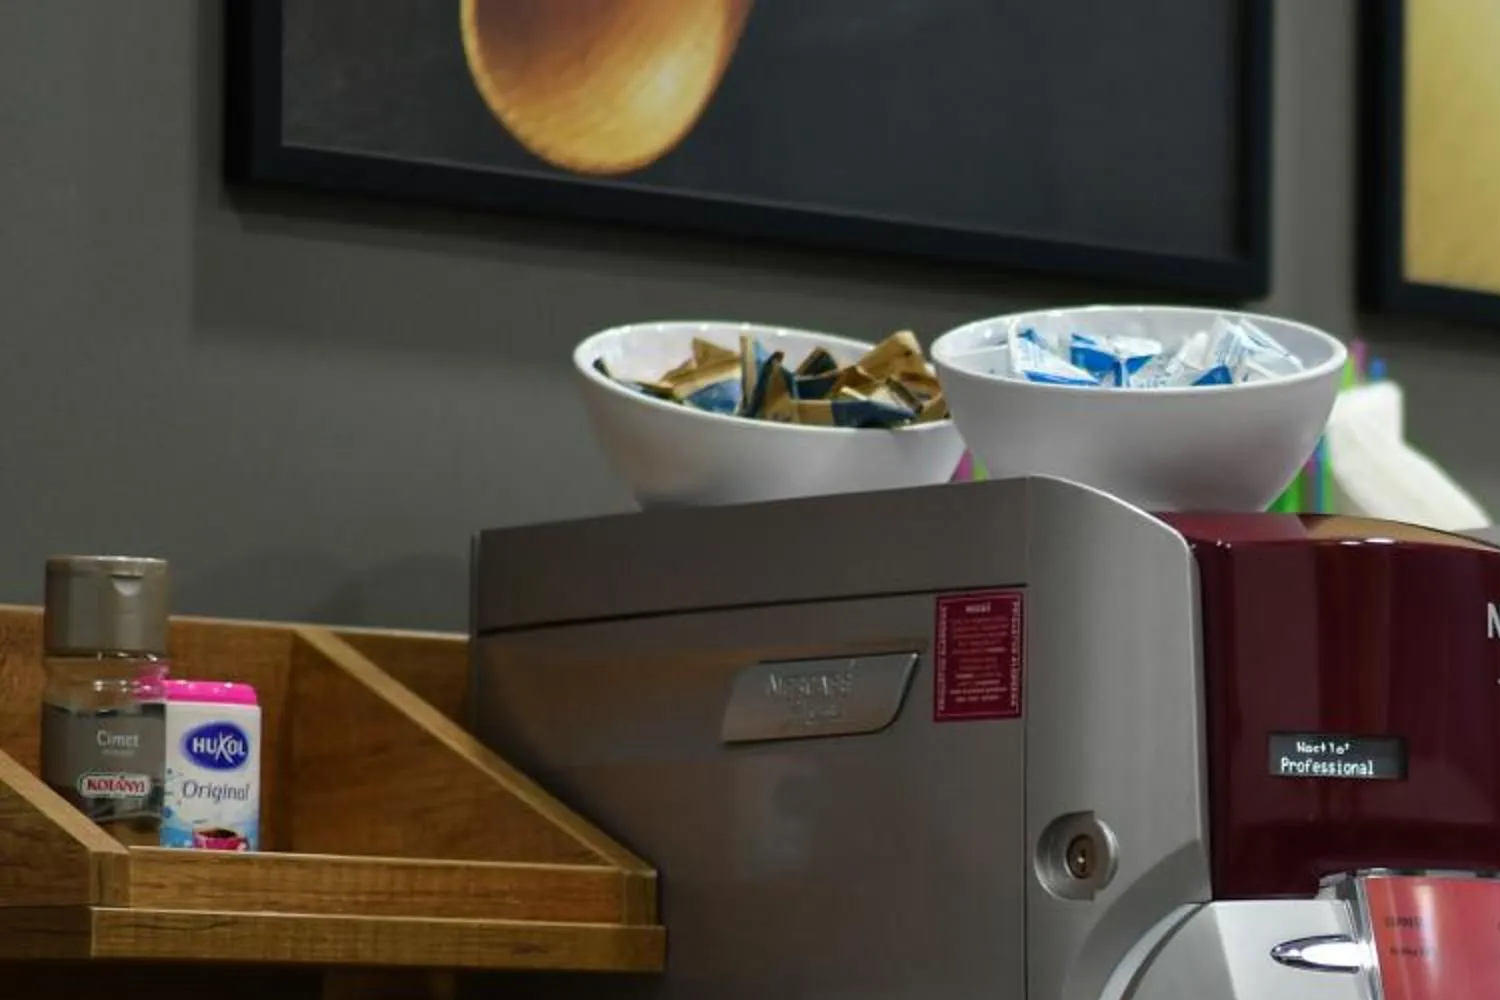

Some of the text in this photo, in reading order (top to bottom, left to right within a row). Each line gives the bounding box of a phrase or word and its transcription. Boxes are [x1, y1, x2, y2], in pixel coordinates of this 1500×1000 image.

[193, 732, 245, 764] HUXOL
[1281, 757, 1374, 776] Professional
[183, 779, 250, 804] Original
